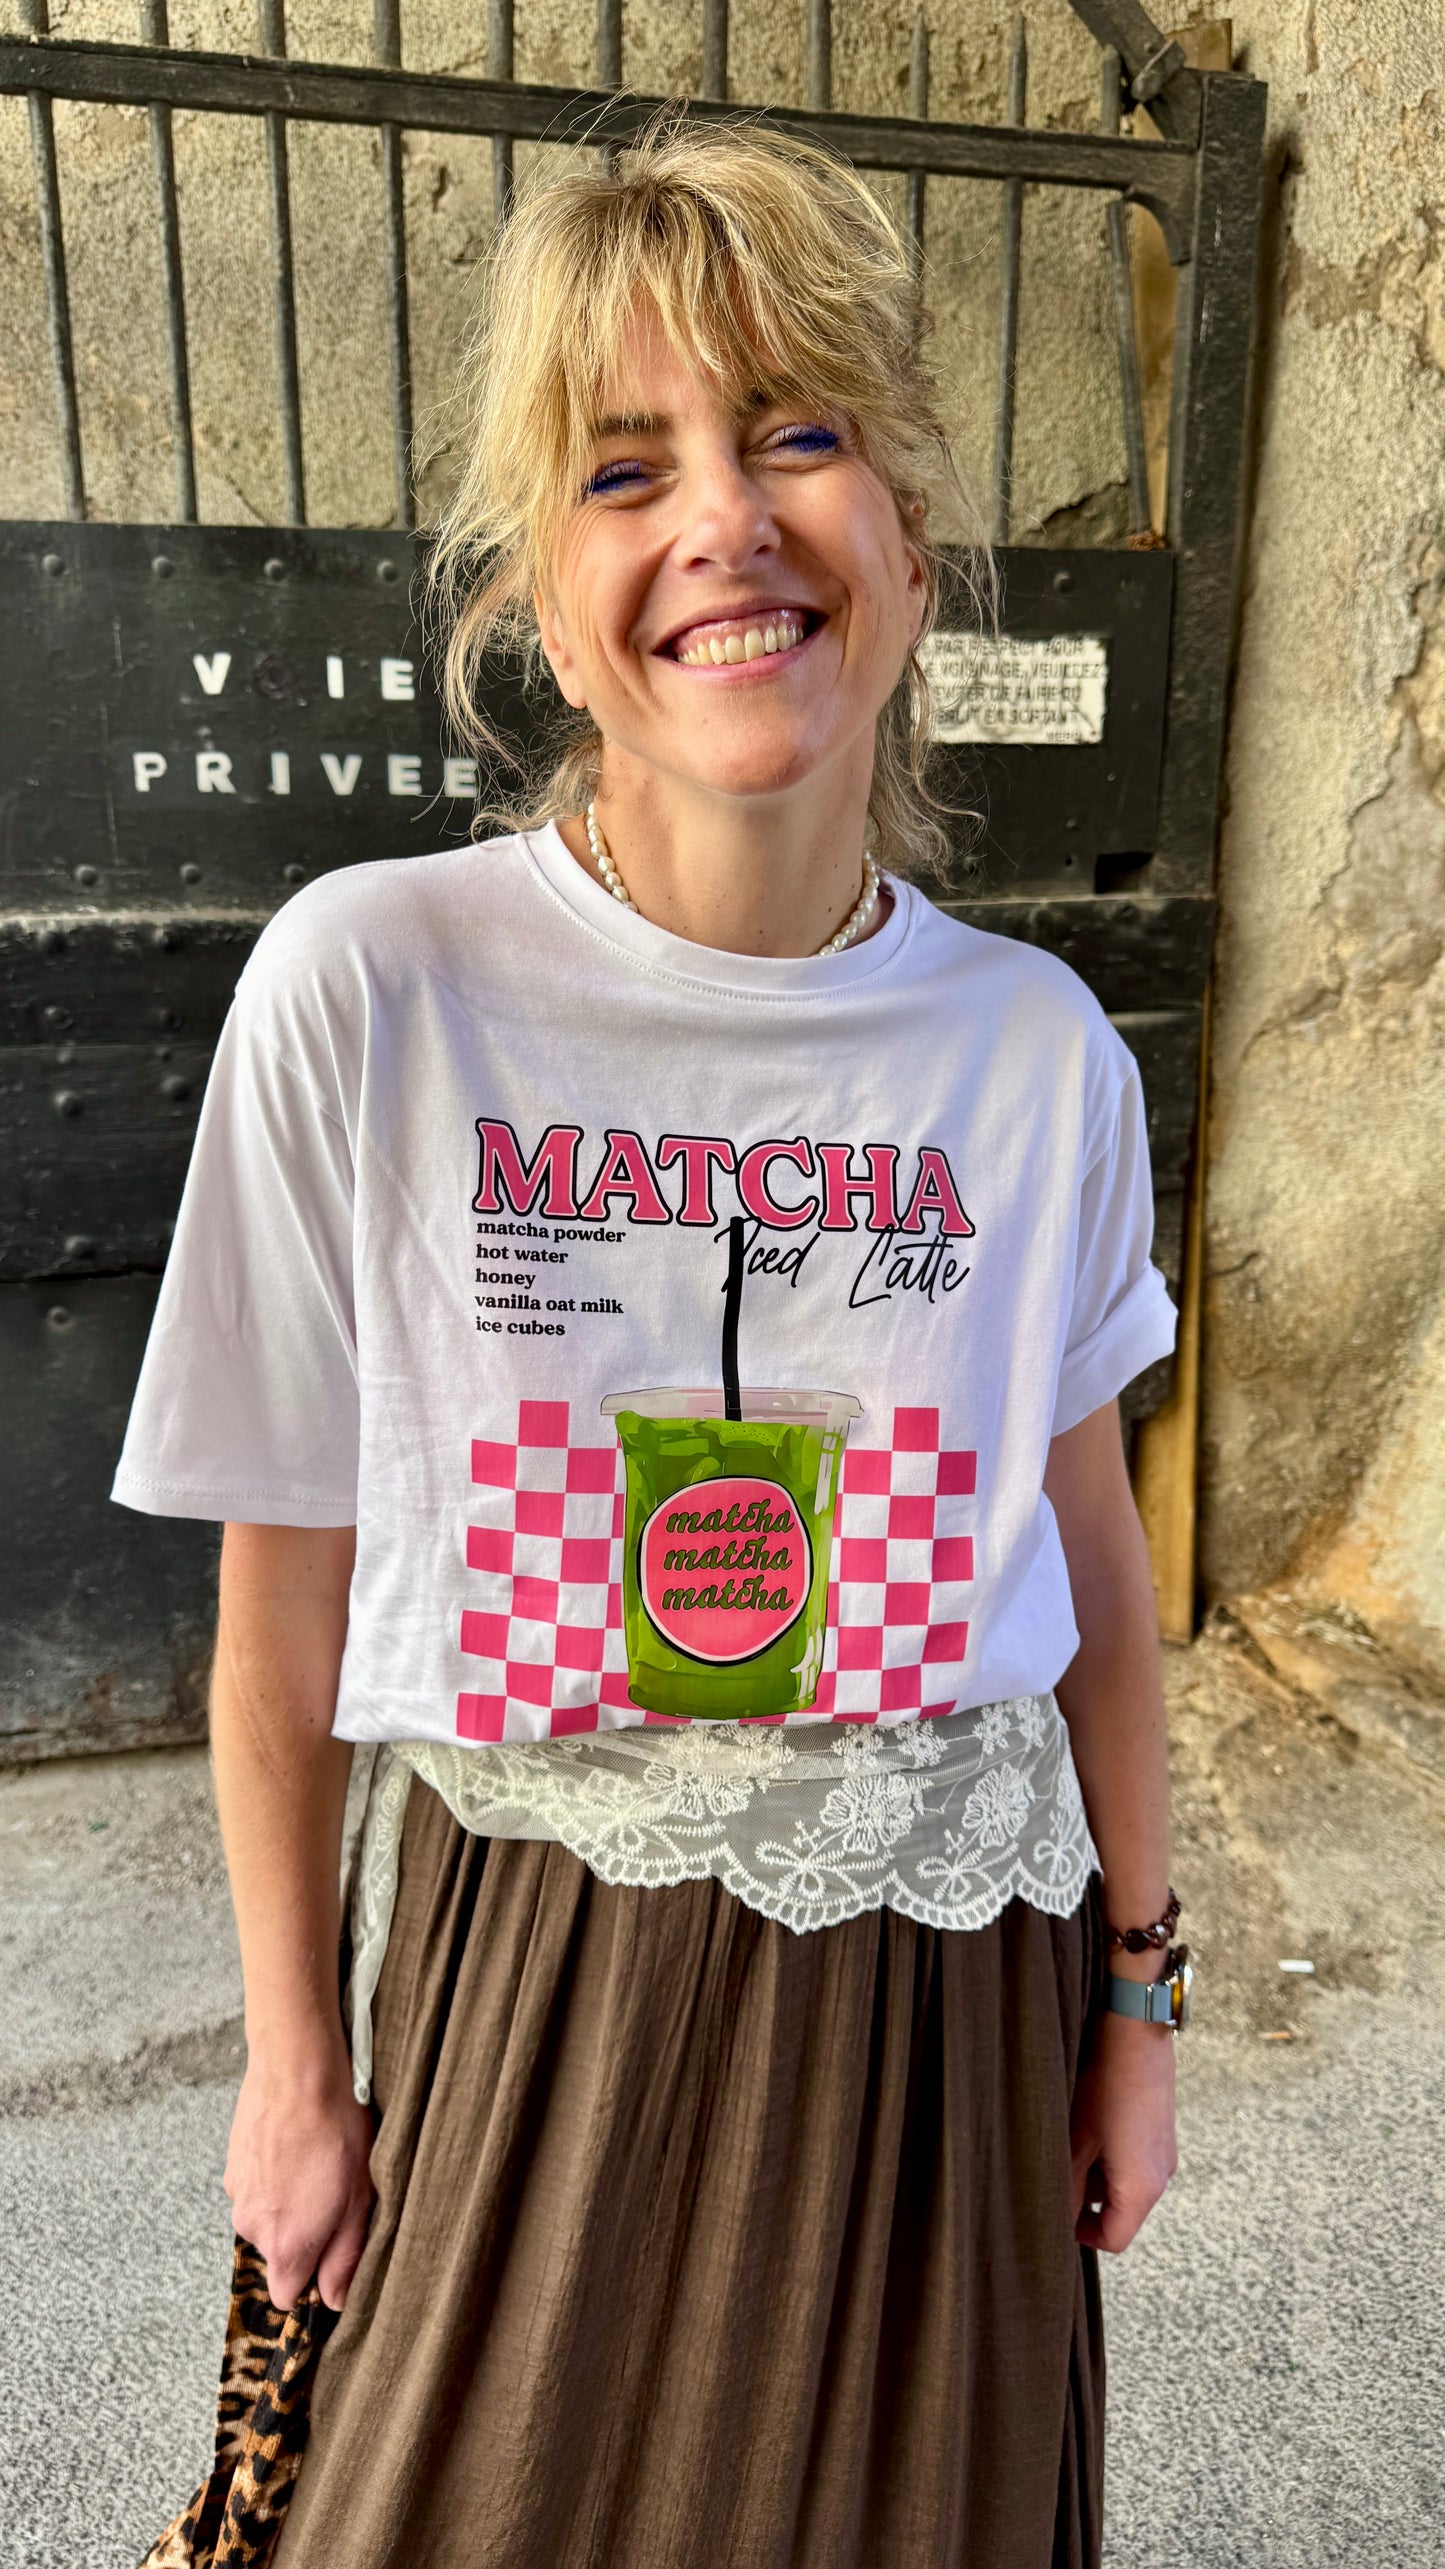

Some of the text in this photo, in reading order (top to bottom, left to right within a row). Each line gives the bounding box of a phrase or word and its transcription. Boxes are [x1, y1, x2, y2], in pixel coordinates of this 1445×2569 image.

[132, 750, 478, 798] PRIVEE
[472, 1117, 975, 1238] MATCHA
[476, 1222, 626, 1243] matcha powder
[475, 1243, 569, 1263] hot water
[849, 1223, 971, 1309] Latte
[475, 1268, 536, 1289] honey
[474, 1293, 624, 1314] vanilla oat milk
[475, 1315, 566, 1336] ice cubes
[665, 1498, 795, 1534] matcha
[662, 1536, 793, 1571] matcha
[661, 1574, 794, 1612] matcha
